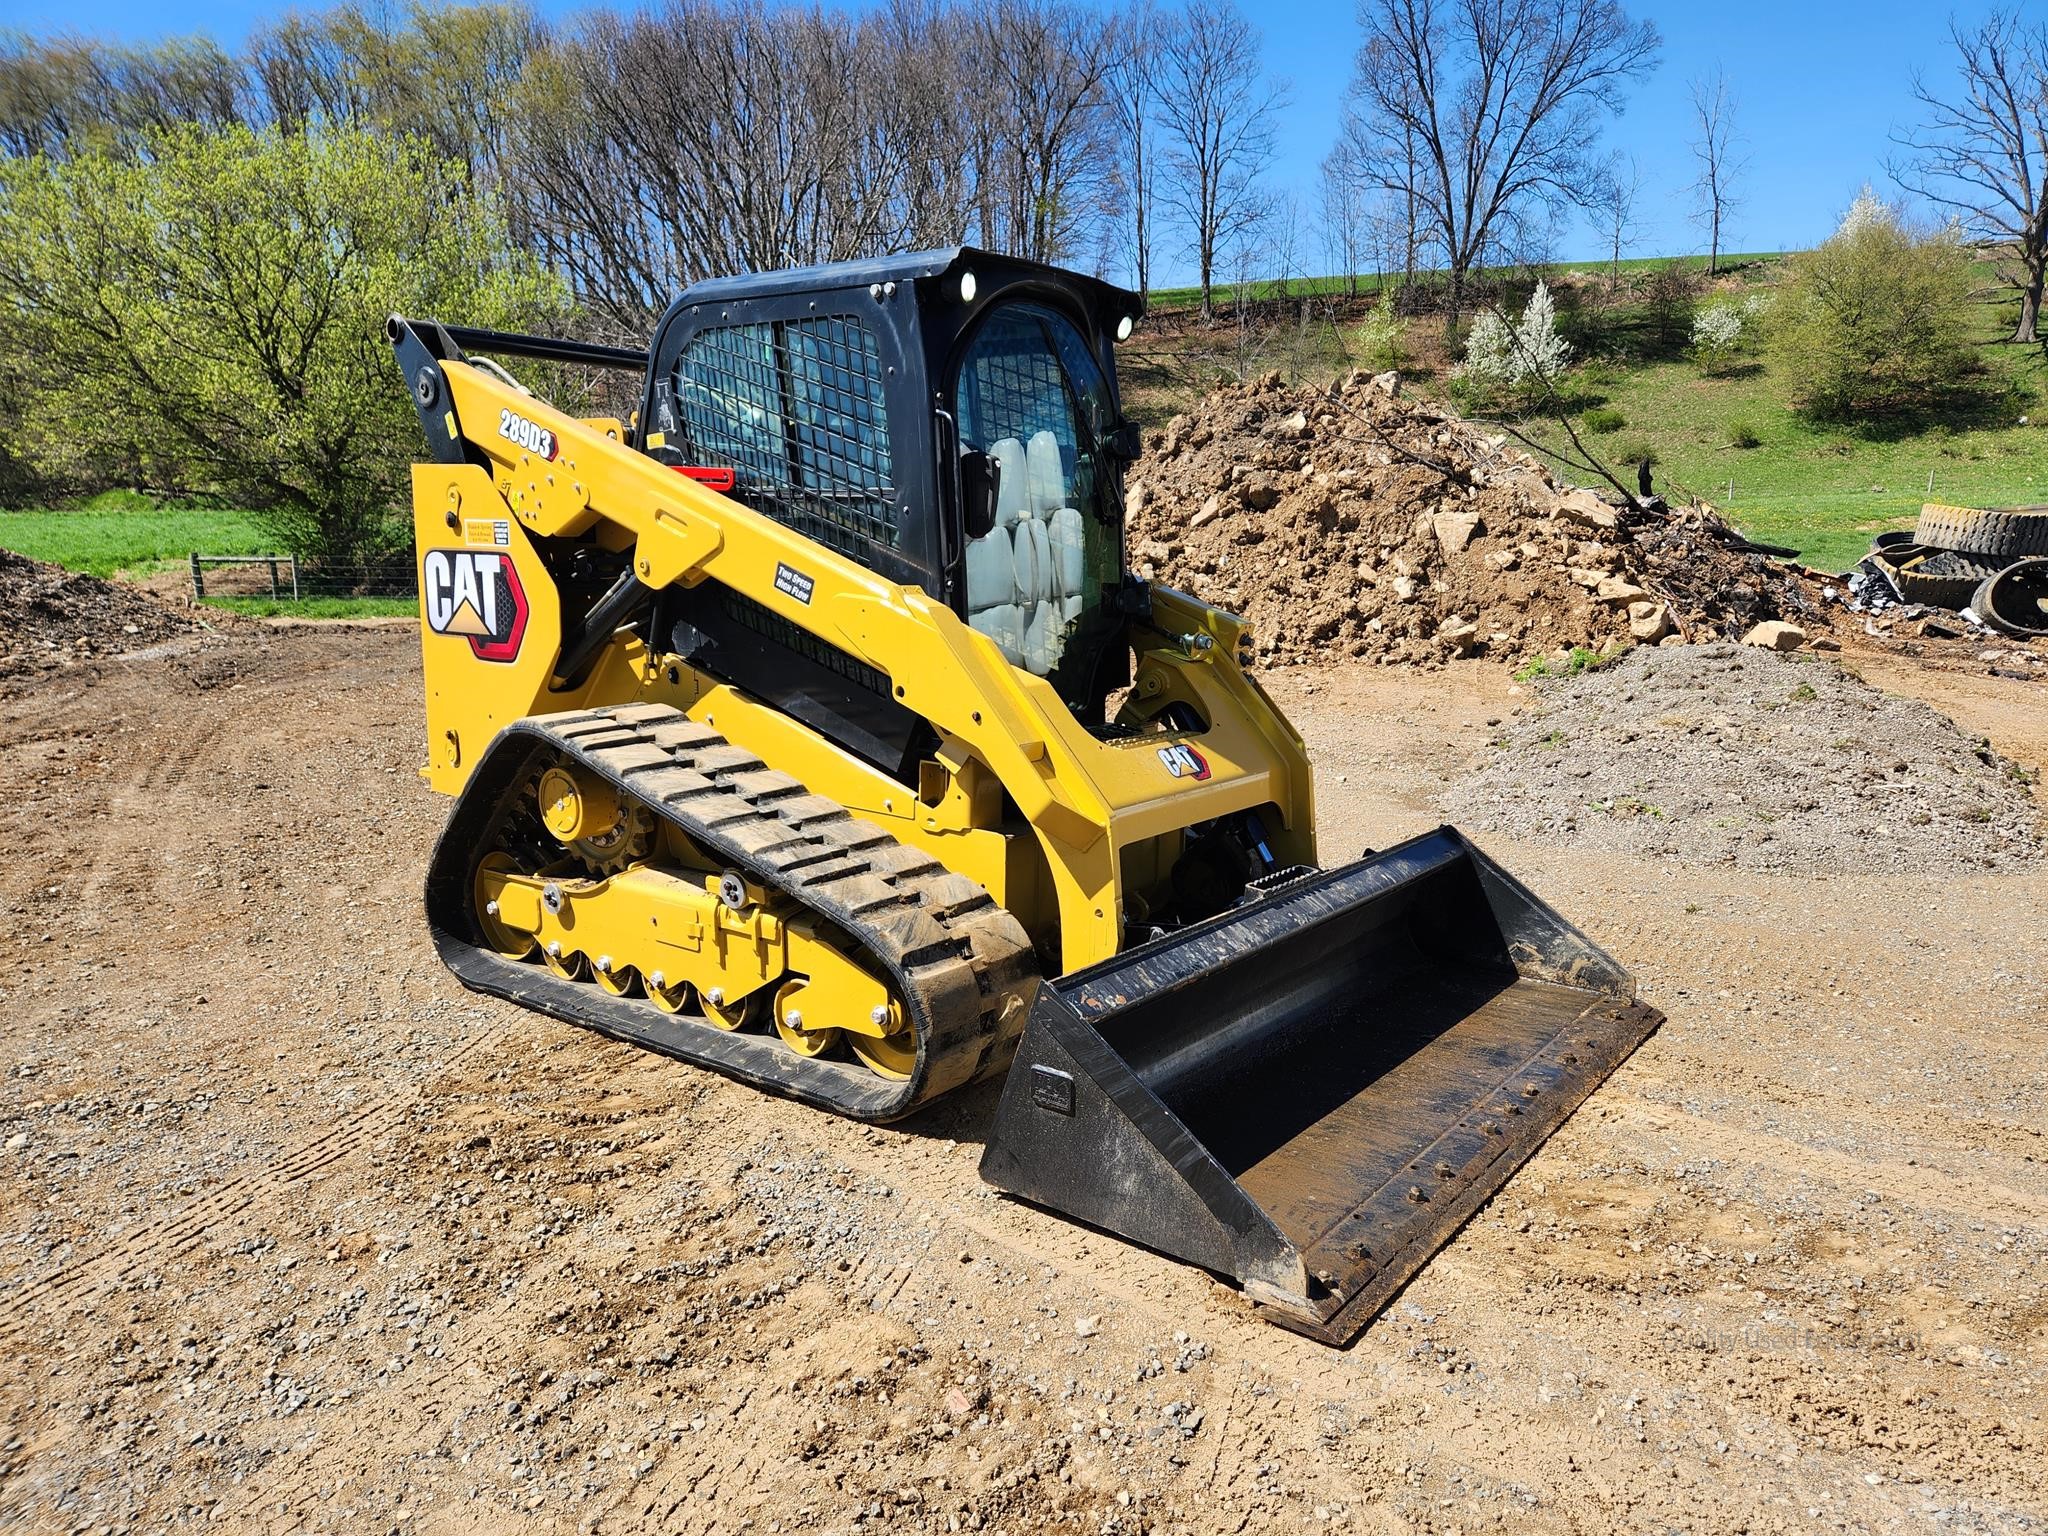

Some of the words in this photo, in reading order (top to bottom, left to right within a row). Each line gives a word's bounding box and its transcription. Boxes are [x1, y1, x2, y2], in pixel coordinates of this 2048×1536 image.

[498, 408, 552, 460] 289D3
[425, 551, 501, 636] CAT
[1157, 746, 1201, 777] CAT
